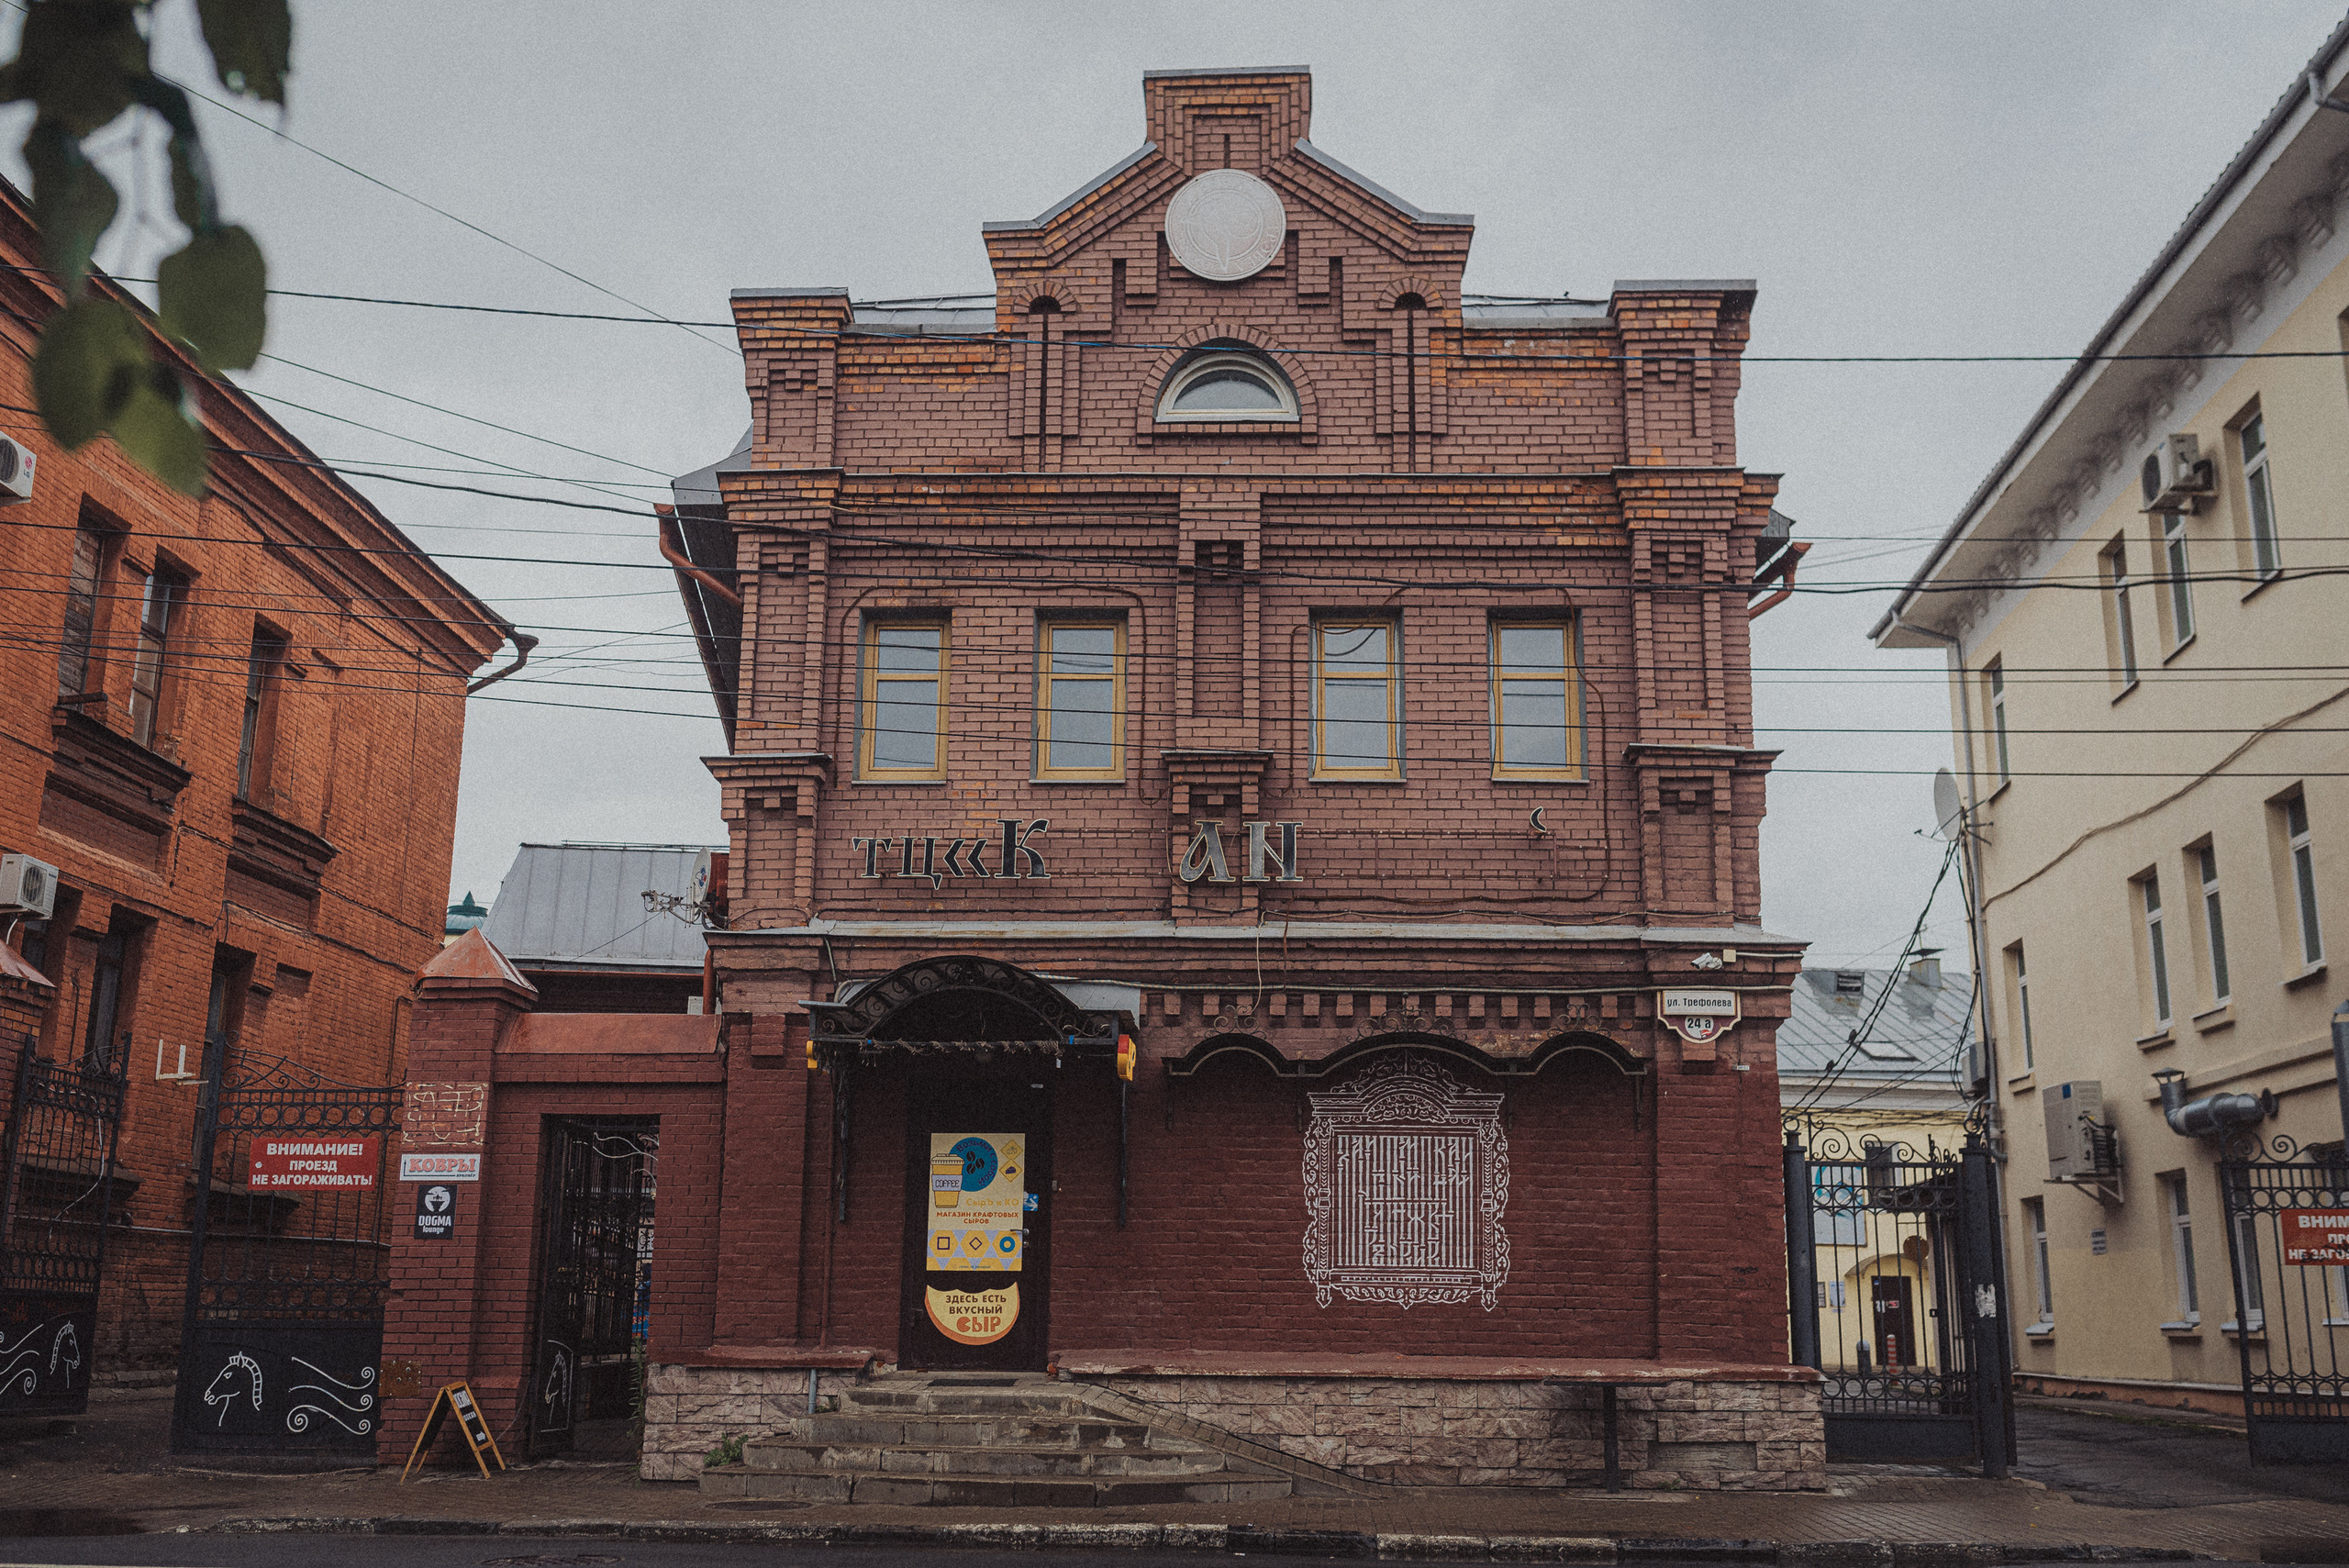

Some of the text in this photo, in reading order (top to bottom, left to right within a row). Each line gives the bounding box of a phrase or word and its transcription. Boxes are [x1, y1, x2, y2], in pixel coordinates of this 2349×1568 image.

[1667, 997, 1731, 1007] ул. Трефолева
[1687, 1018, 1701, 1029] 24
[267, 1143, 363, 1156] ВНИМАНИЕ!
[289, 1161, 338, 1173] ПРОЕЗД
[409, 1158, 476, 1173] КОВРЫ
[252, 1174, 373, 1185] НЕ ЗАГОРАЖИВАТЬ!
[935, 1179, 960, 1188] COFFEE
[418, 1215, 451, 1226] DOGMA
[2298, 1216, 2349, 1229] ВНИМ
[423, 1225, 444, 1234] lounge
[946, 1295, 1007, 1304] ЗДЕСЬ ЕСТЬ
[949, 1305, 1003, 1314] ВКУСНЫЙ
[956, 1316, 1001, 1333] СЫР
